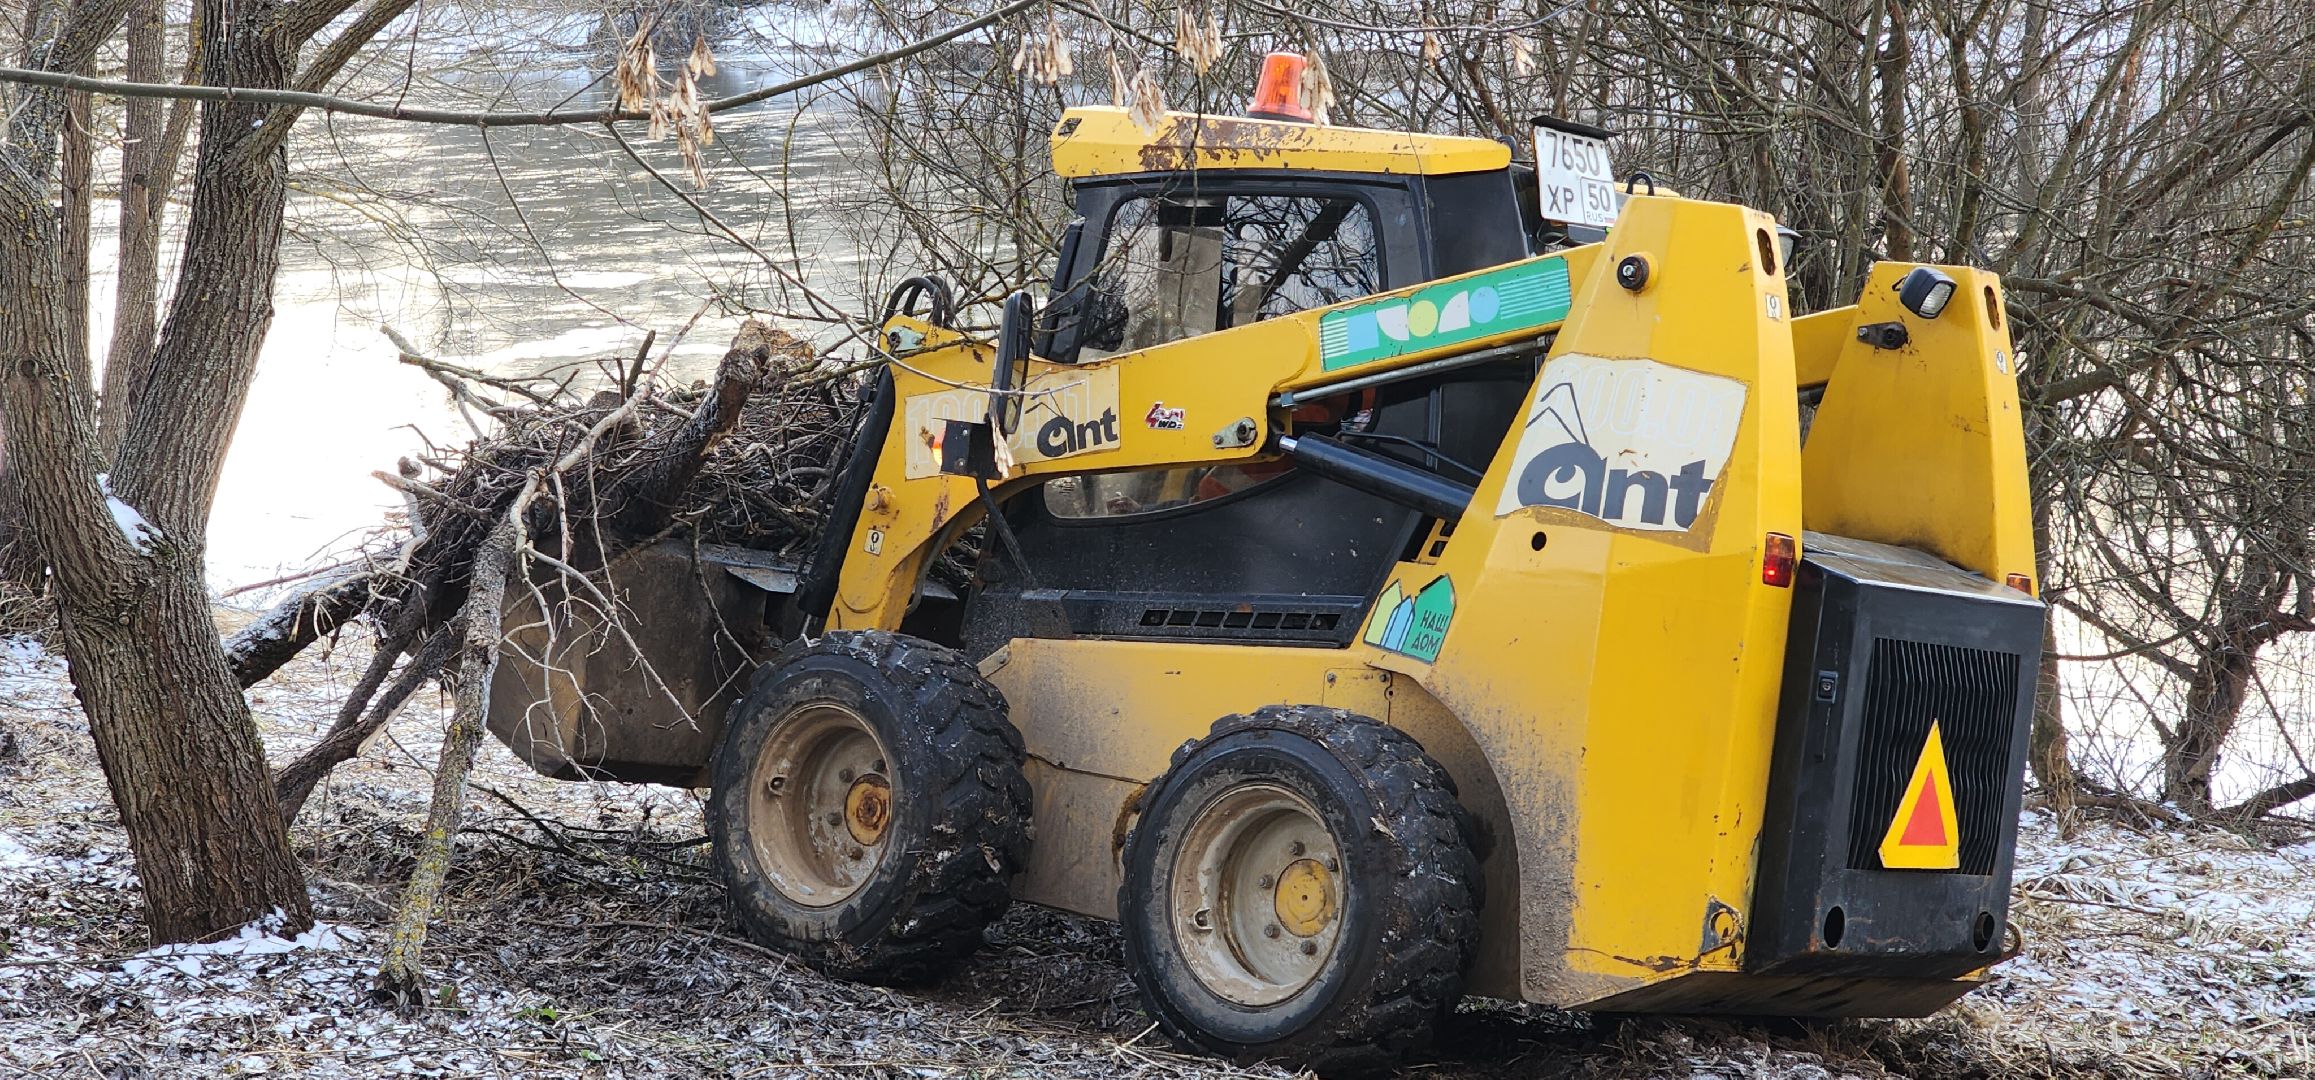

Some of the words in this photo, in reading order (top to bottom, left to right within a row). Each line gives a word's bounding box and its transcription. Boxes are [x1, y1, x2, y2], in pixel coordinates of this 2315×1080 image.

[1545, 131, 1600, 176] 7650
[1588, 182, 1611, 212] 50
[1586, 210, 1604, 223] RUS
[1037, 407, 1119, 458] ant
[1517, 442, 1715, 529] ant
[1420, 609, 1449, 633] НАШ
[1411, 630, 1440, 655] ДОМ
